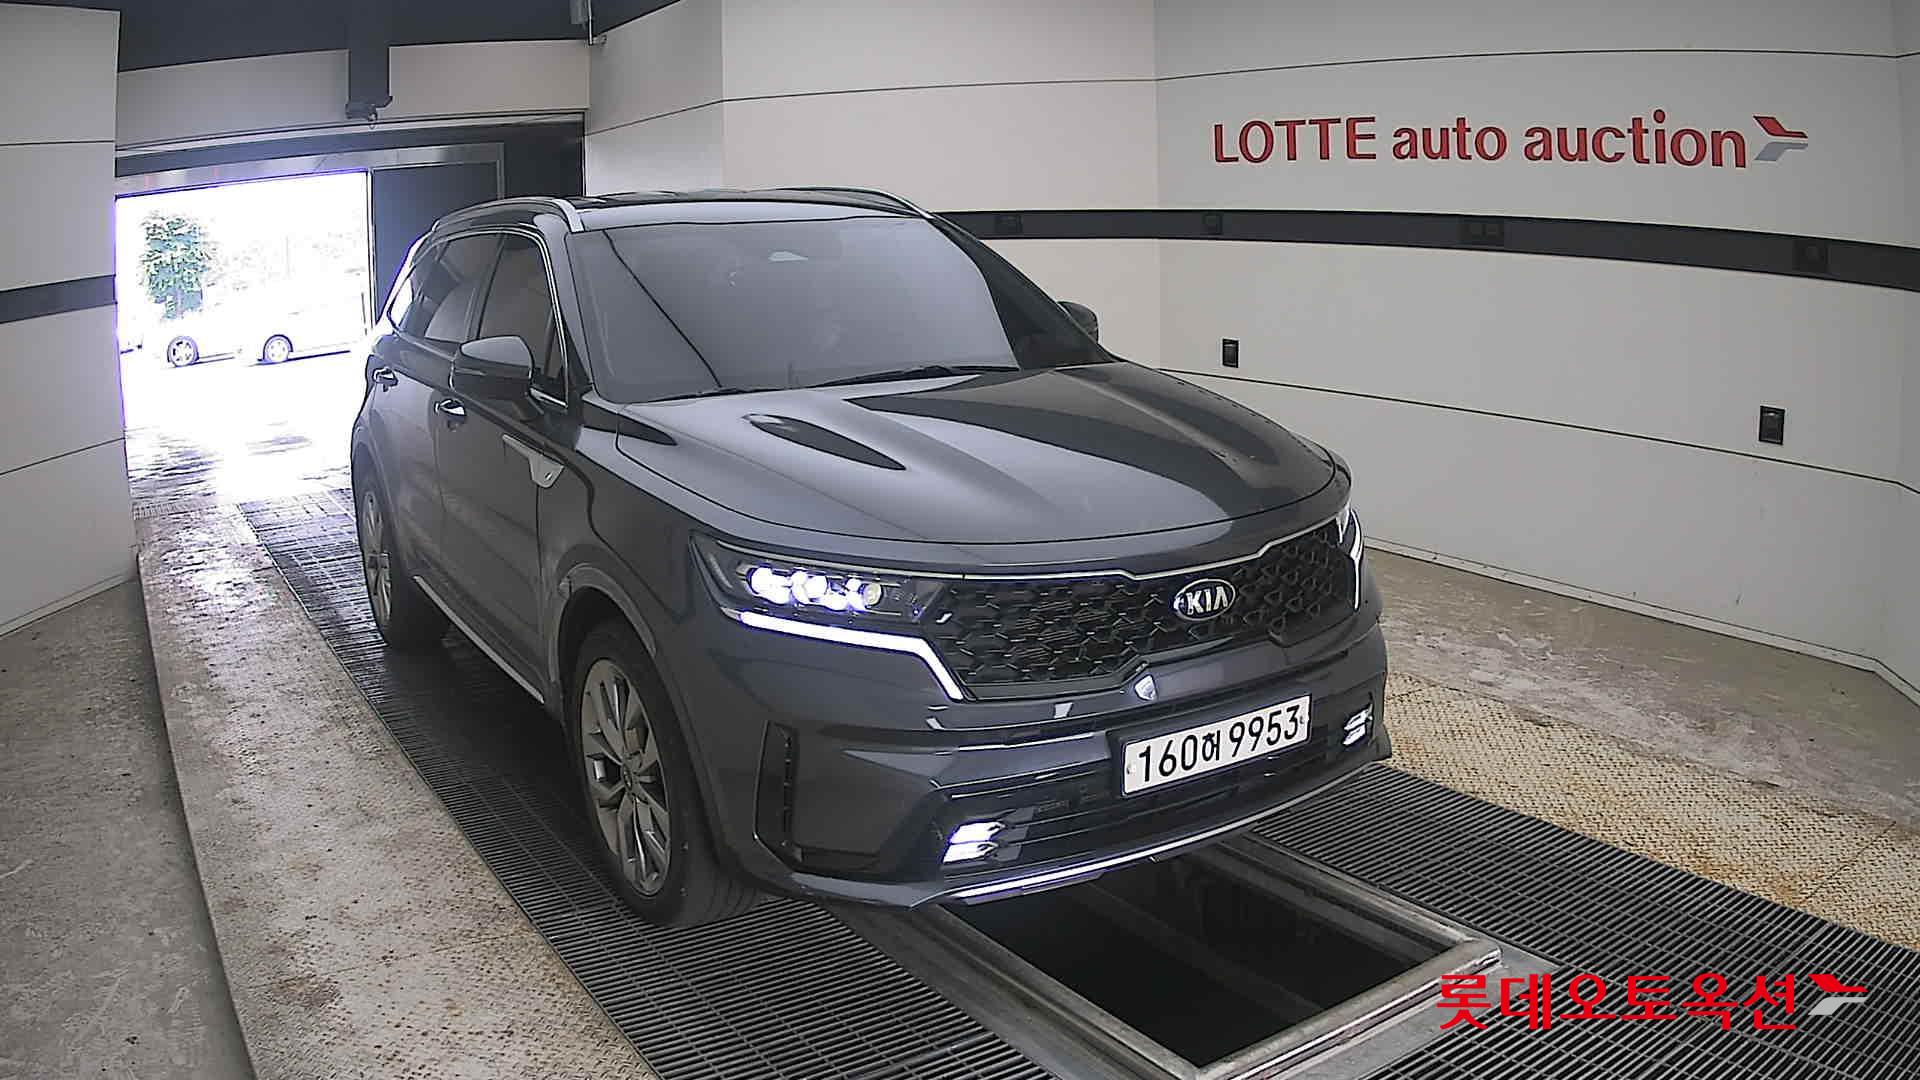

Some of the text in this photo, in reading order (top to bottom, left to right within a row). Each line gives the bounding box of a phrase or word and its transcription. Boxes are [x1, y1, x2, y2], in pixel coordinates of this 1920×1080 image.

[1213, 109, 1748, 169] LOTTE auto auction
[1185, 586, 1229, 616] KIA
